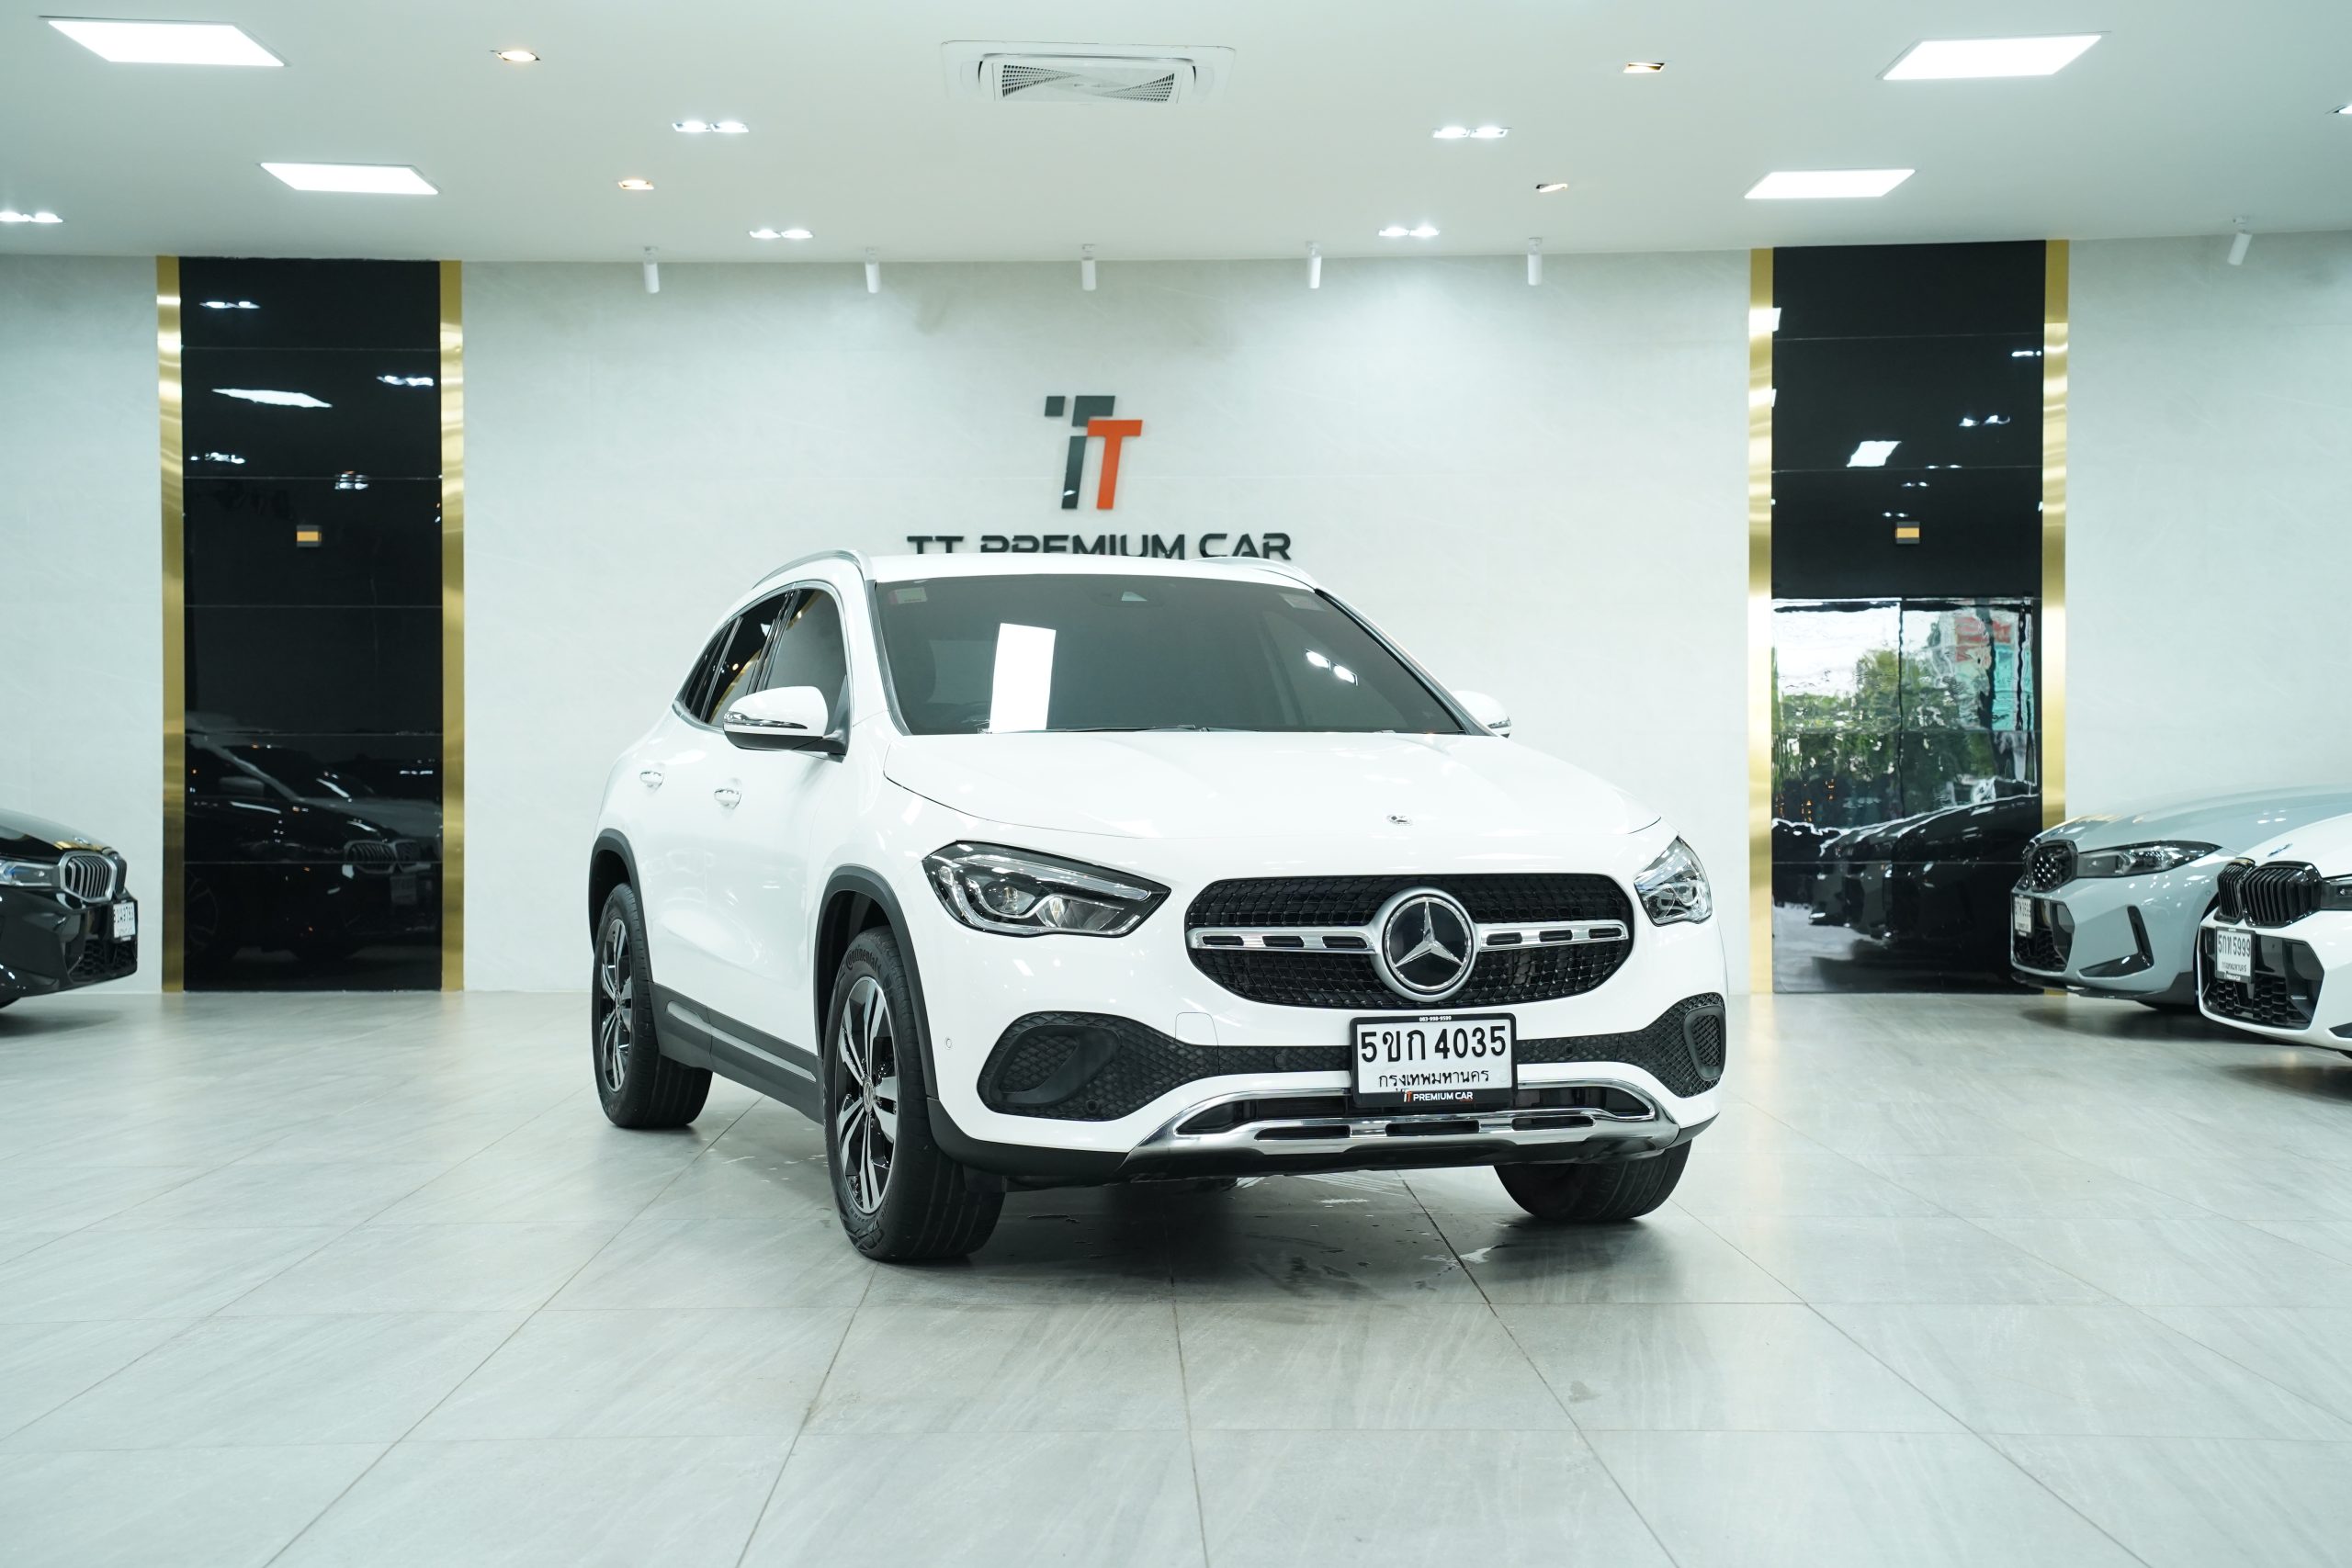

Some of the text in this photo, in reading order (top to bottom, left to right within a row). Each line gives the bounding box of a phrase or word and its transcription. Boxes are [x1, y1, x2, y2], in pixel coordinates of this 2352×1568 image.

[1199, 533, 1292, 560] CAR
[846, 945, 878, 972] Continental
[2233, 936, 2251, 957] 5999
[1361, 1025, 1506, 1062] 5ขก 4035
[1378, 1069, 1489, 1091] กรุงเทพมหานคร
[1413, 1092, 1453, 1101] PREMIUM
[1454, 1091, 1473, 1100] CAR
